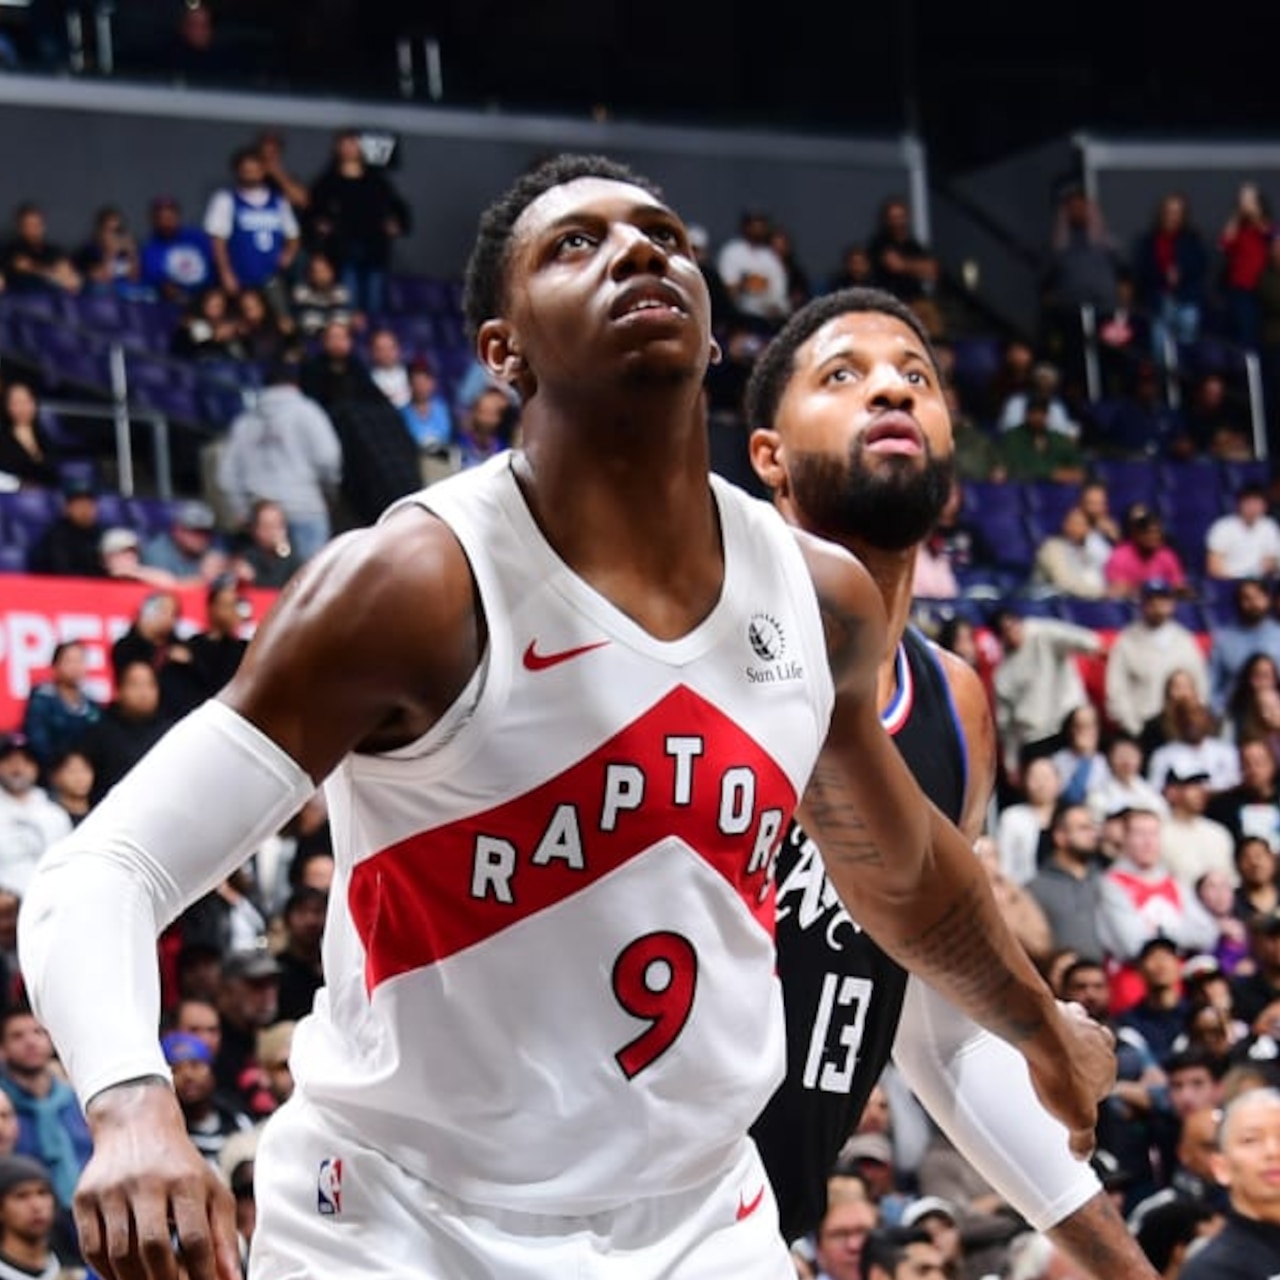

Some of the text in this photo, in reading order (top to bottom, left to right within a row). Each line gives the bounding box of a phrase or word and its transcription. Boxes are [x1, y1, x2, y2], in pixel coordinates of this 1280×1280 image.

[746, 660, 803, 683] Sun Life
[612, 930, 699, 1081] 9
[803, 972, 874, 1094] 13
